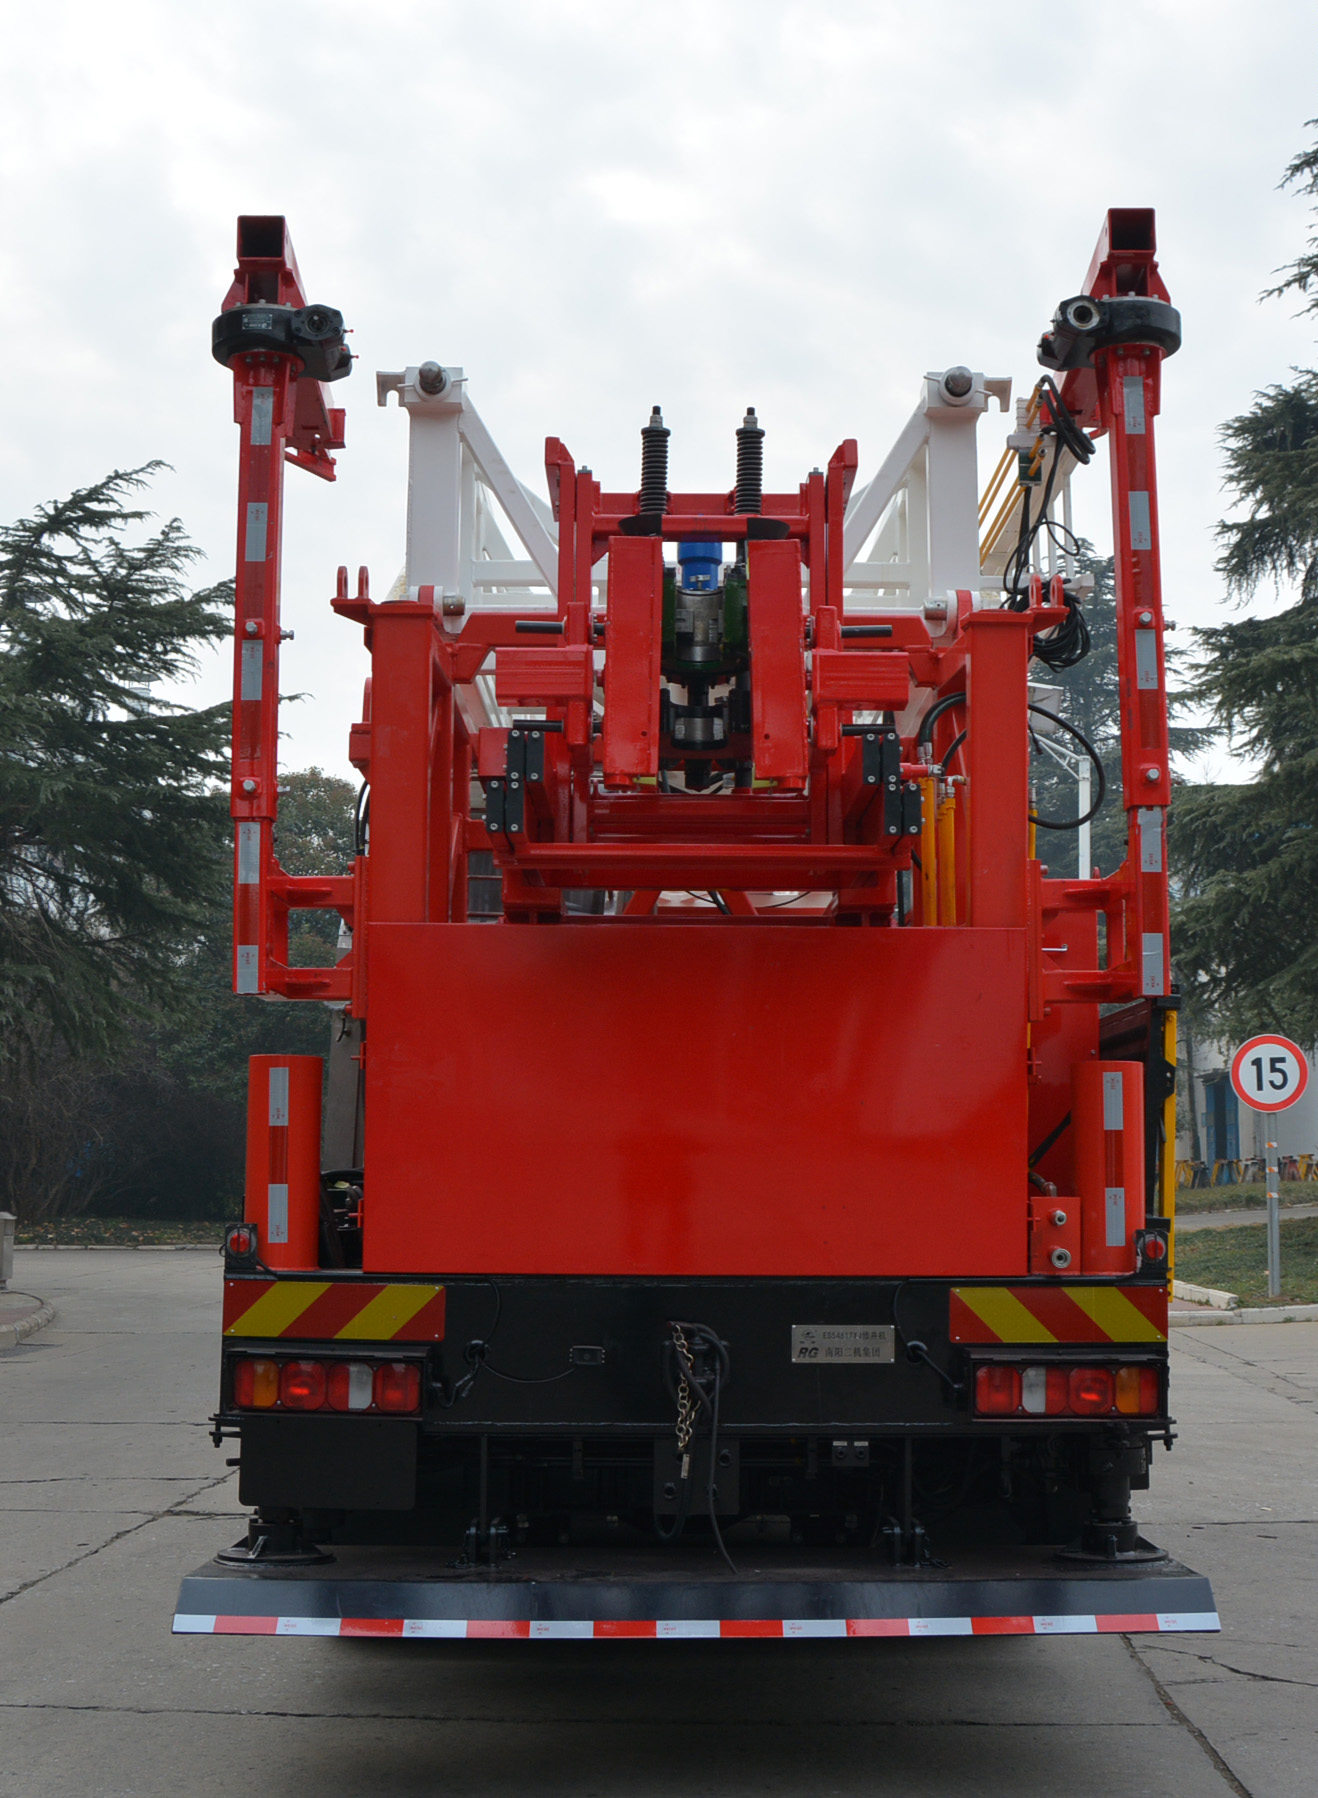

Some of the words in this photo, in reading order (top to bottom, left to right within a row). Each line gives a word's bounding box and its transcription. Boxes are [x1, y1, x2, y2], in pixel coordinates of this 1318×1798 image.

[1251, 1057, 1288, 1091] 15
[797, 1346, 819, 1359] RG
[825, 1346, 881, 1358] 南阳二机集团
